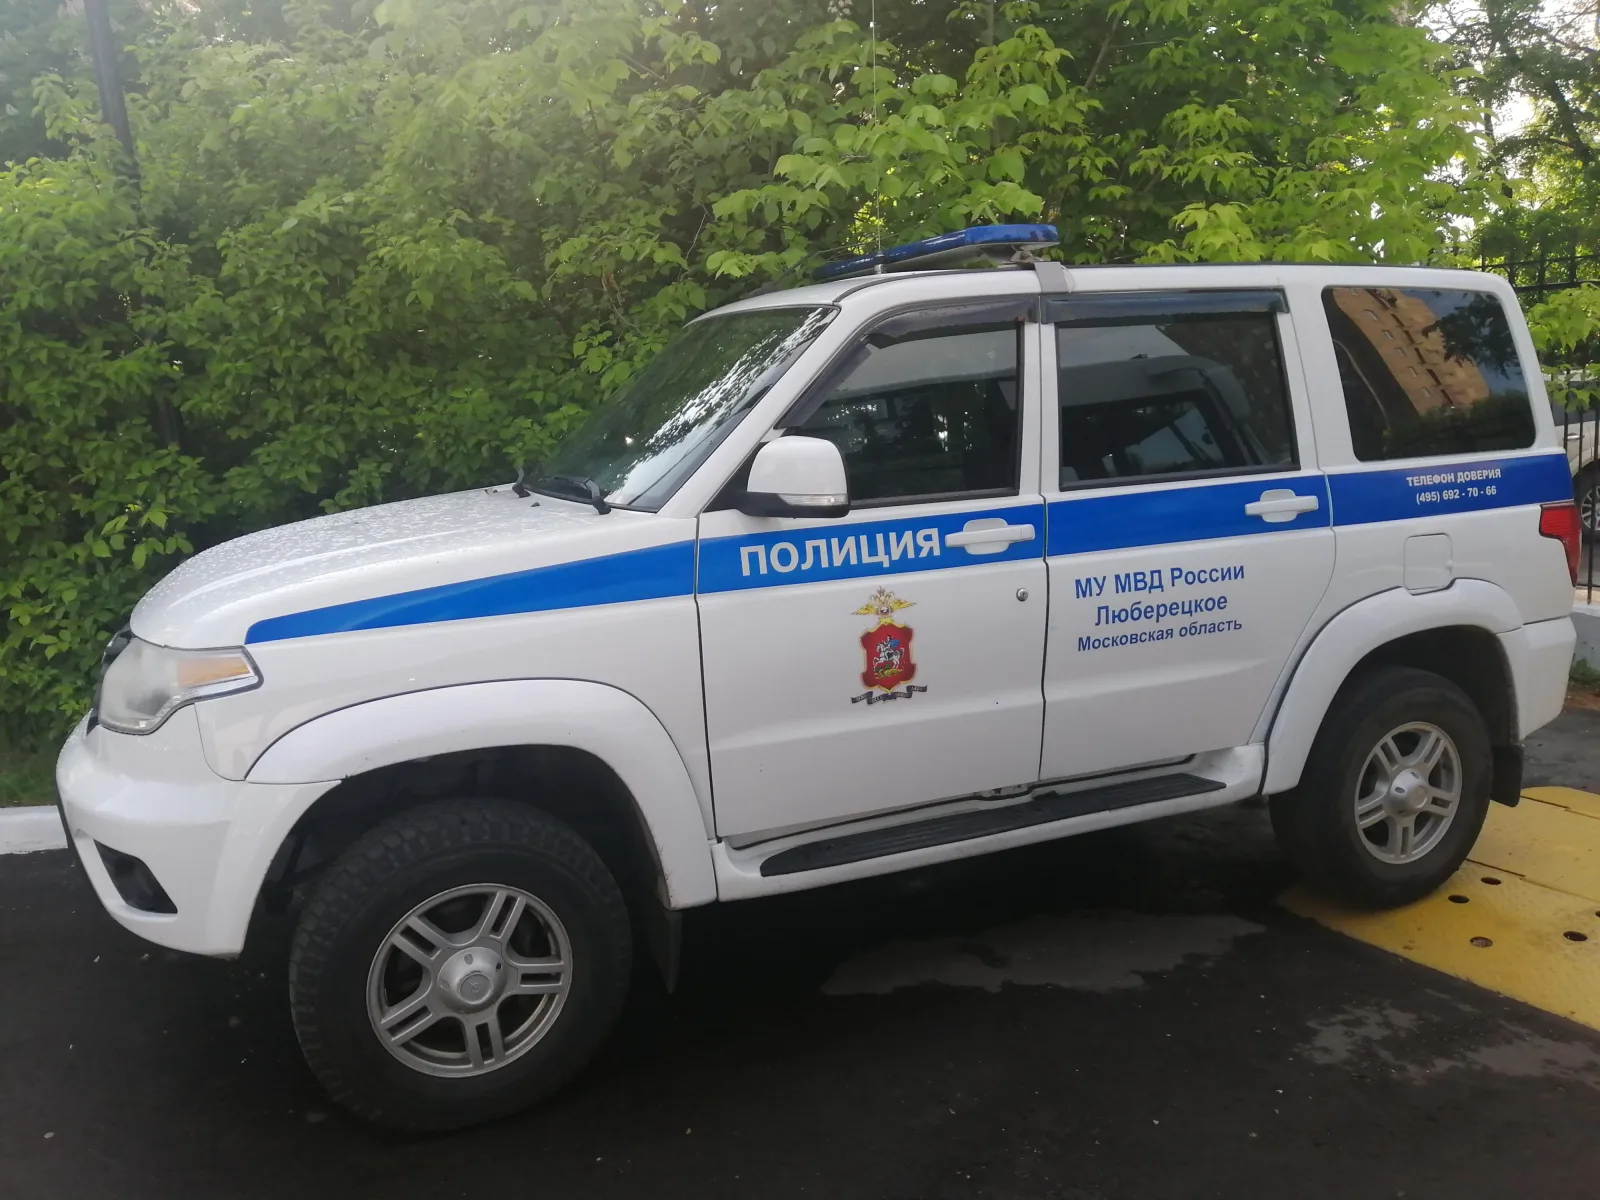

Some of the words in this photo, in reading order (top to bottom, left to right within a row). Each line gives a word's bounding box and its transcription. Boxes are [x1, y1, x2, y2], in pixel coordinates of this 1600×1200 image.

[1406, 472, 1455, 487] ТЕЛЕФОН
[1457, 468, 1502, 483] ДОВЕРИЯ
[1416, 490, 1440, 505] (495)
[1442, 489, 1460, 500] 692
[1467, 487, 1479, 498] 70
[1485, 485, 1497, 496] 66
[740, 528, 941, 576] ПОЛИЦИЯ
[1075, 575, 1107, 599] МУ
[1114, 569, 1165, 594] МВД
[1170, 565, 1245, 587] России
[1094, 595, 1228, 626] Люберецкое
[1077, 627, 1174, 652] Московская
[1179, 619, 1242, 638] область
